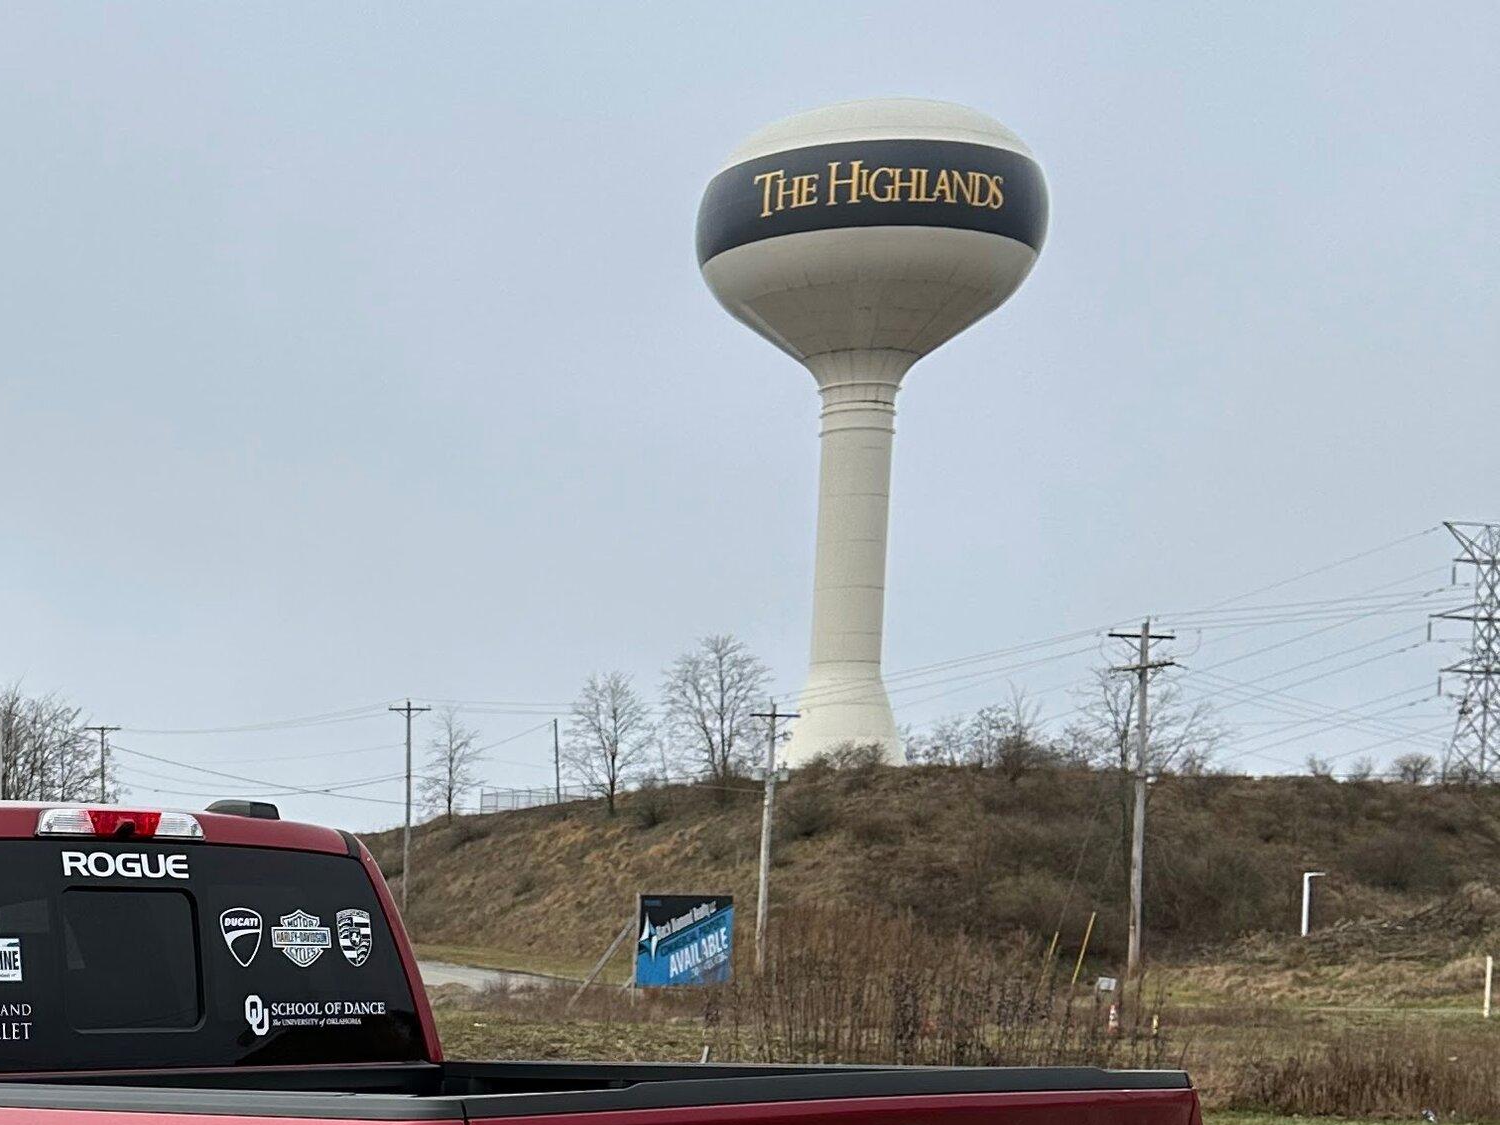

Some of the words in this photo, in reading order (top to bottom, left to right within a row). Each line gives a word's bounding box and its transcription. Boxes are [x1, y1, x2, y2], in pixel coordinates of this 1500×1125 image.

[61, 851, 190, 879] ROGUE
[224, 917, 259, 927] DUCATI
[669, 926, 728, 979] AVAILABLE
[271, 1002, 322, 1016] SCHOOL
[324, 1002, 341, 1015] OF
[344, 1002, 386, 1015] DANCE
[281, 1018, 319, 1026] UNIVERSITY
